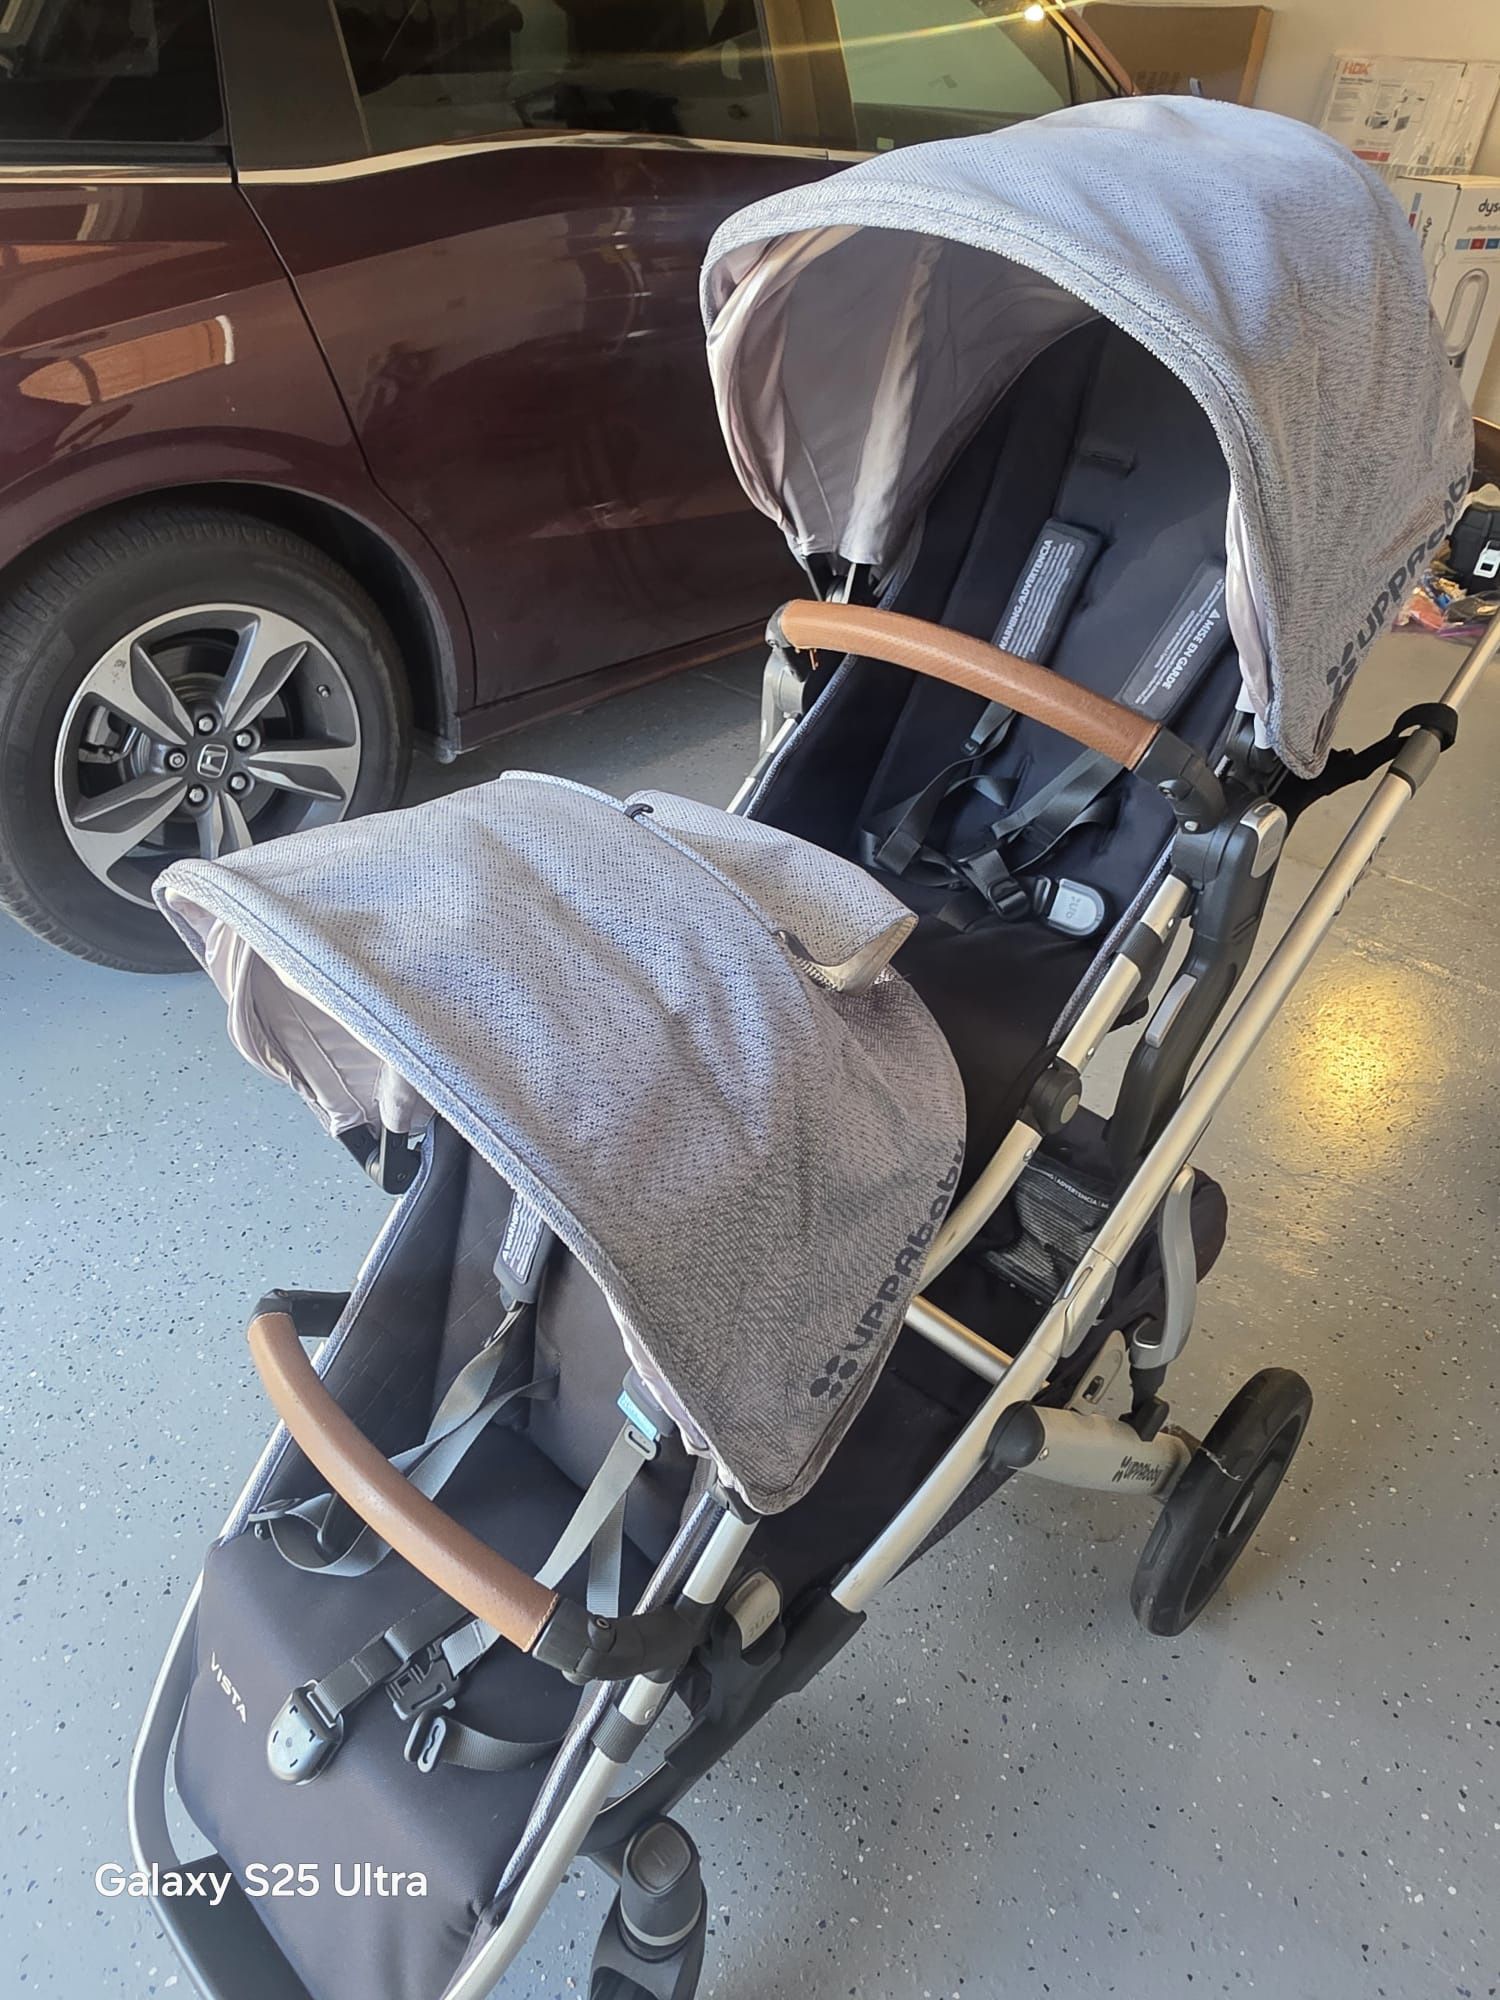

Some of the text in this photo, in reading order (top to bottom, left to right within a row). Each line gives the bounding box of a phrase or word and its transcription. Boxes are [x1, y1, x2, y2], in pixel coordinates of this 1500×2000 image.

[1478, 198, 1500, 217] dys
[1162, 618, 1214, 690] MISE EN GARDE
[210, 1651, 247, 1724] VISTA
